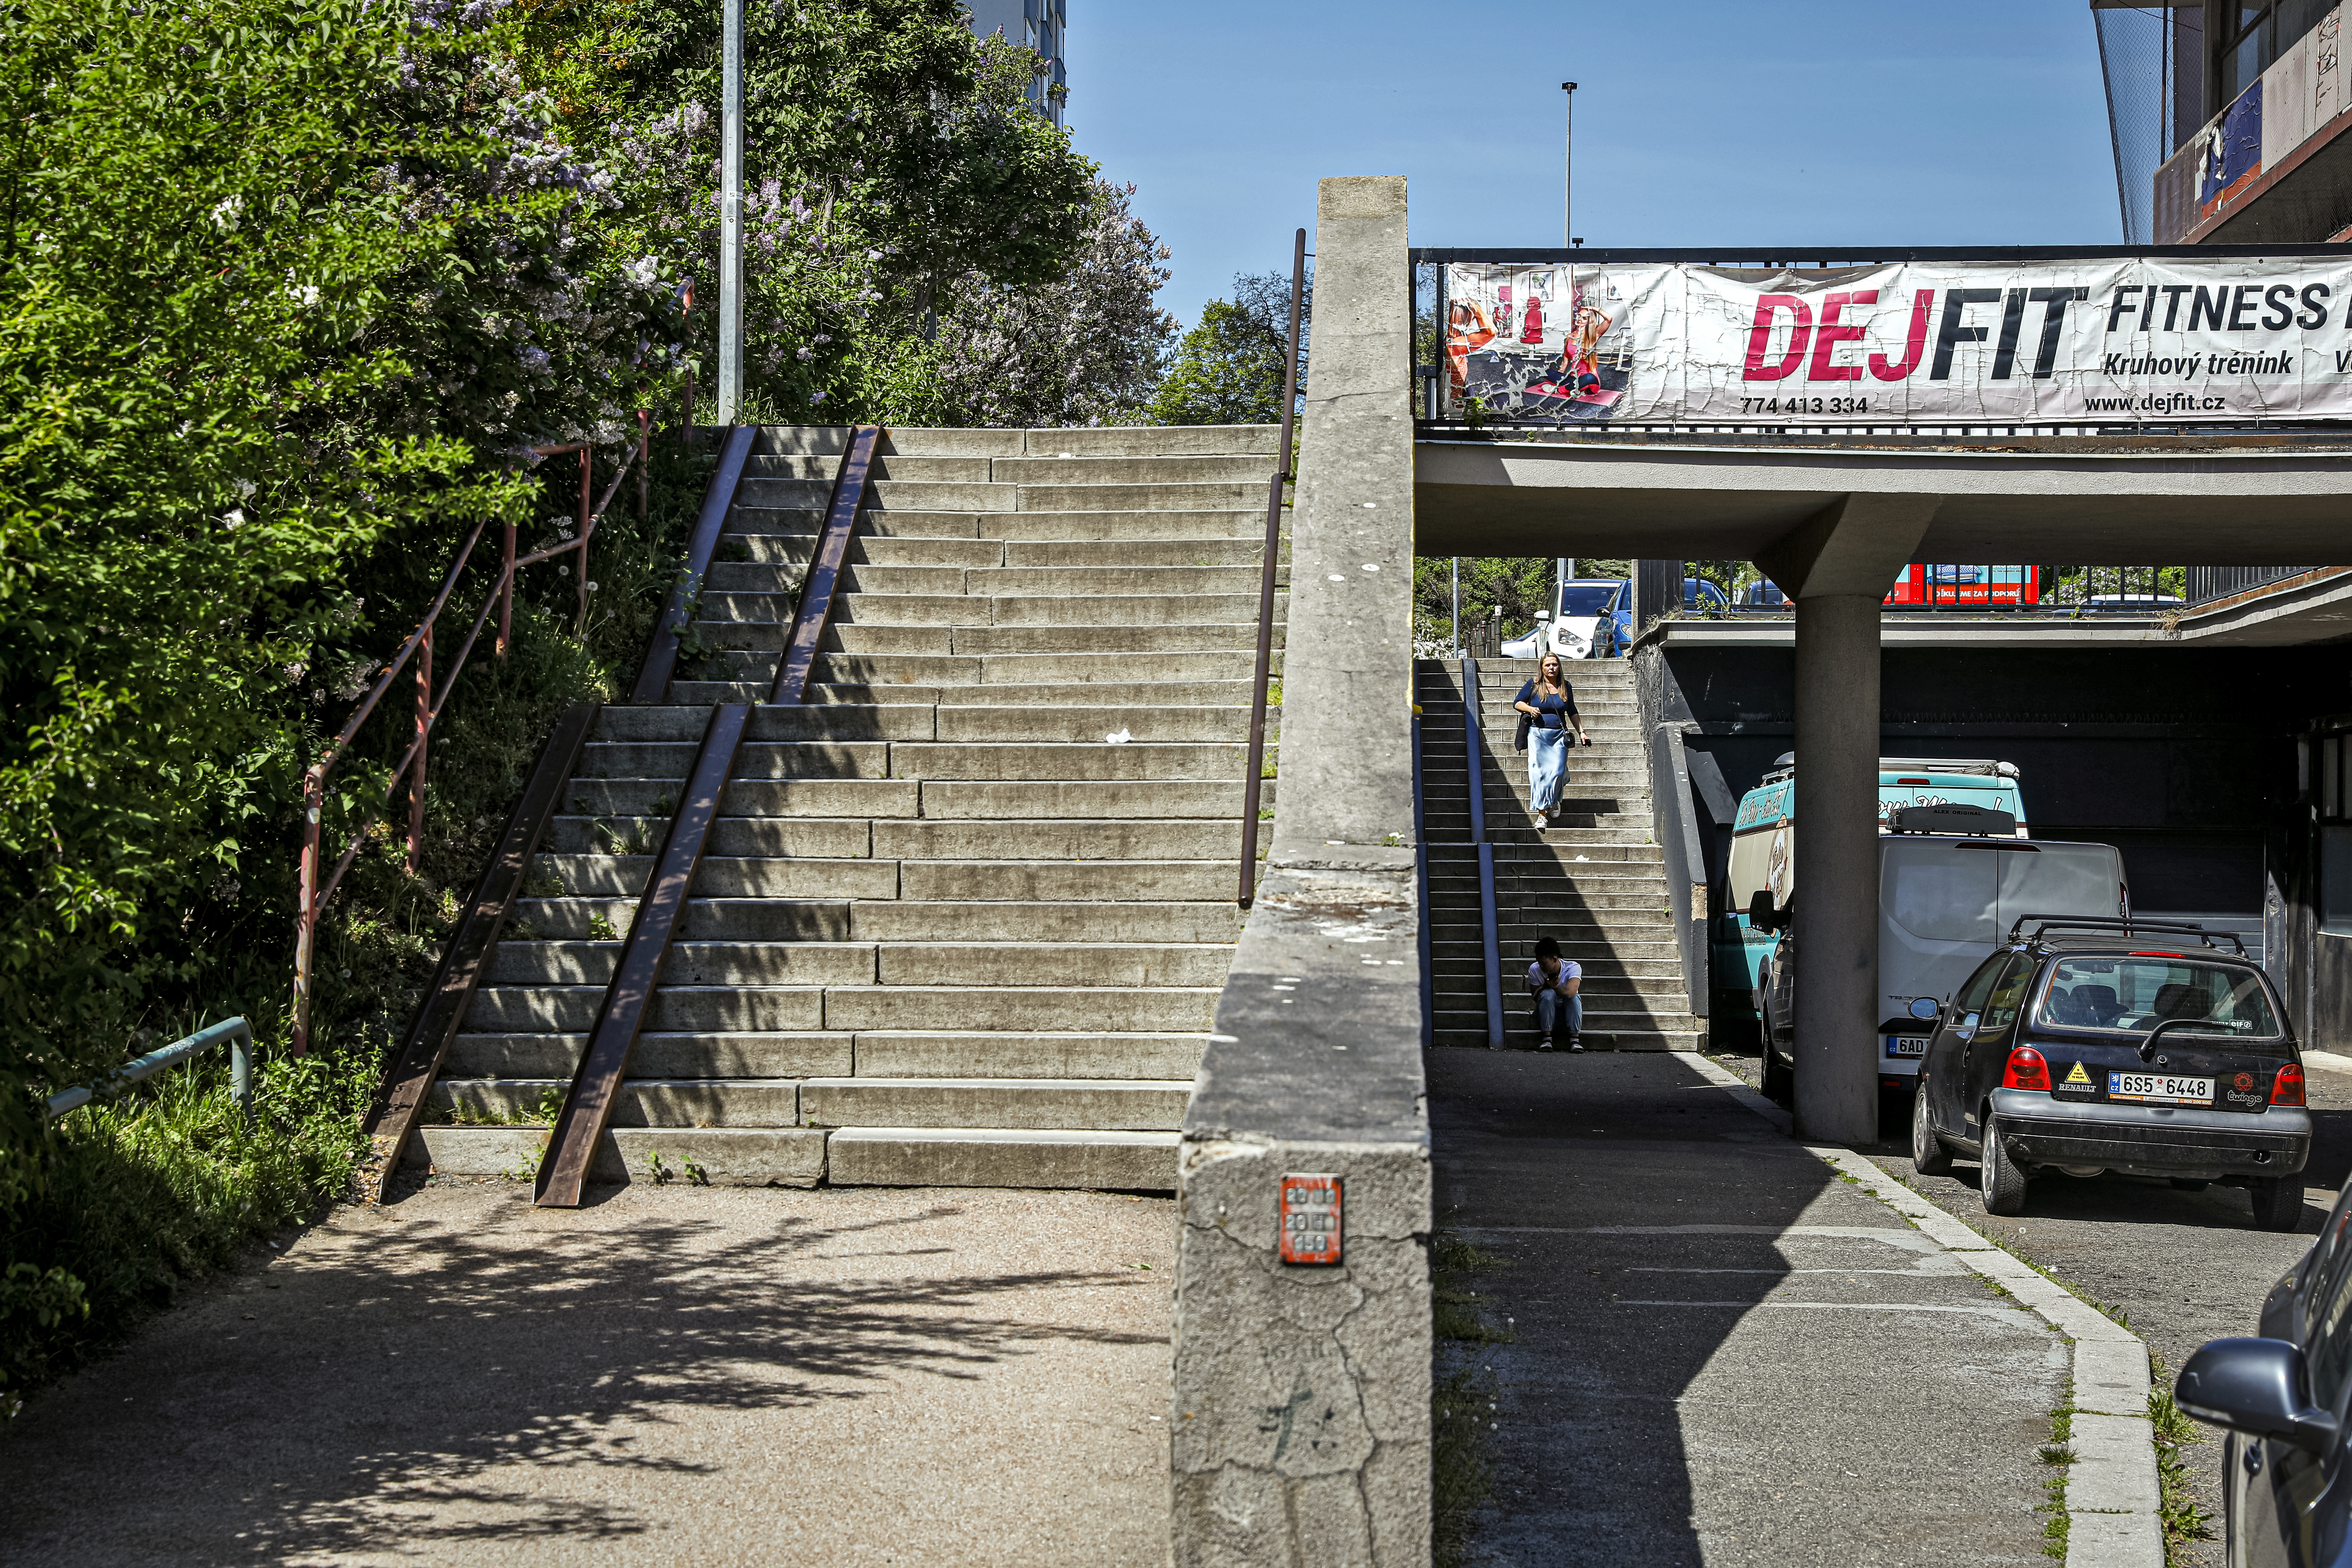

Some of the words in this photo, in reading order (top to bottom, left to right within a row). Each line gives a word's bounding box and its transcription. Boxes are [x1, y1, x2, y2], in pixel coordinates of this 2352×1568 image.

[2107, 283, 2330, 332] FITNESS
[2103, 351, 2202, 380] Kruhový
[2208, 350, 2294, 375] trénink
[1740, 397, 1782, 414] 774
[1785, 397, 1825, 414] 413
[1829, 397, 1868, 414] 334
[2086, 393, 2225, 416] www.dejfit.cz
[1936, 589, 1971, 597] DĚKUME
[1899, 1039, 1924, 1053] 6AD
[2058, 1083, 2096, 1093] RENAULT
[2124, 1076, 2153, 1093] 6S5
[2166, 1079, 2206, 1096] 6448
[2228, 1090, 2262, 1106] twingo
